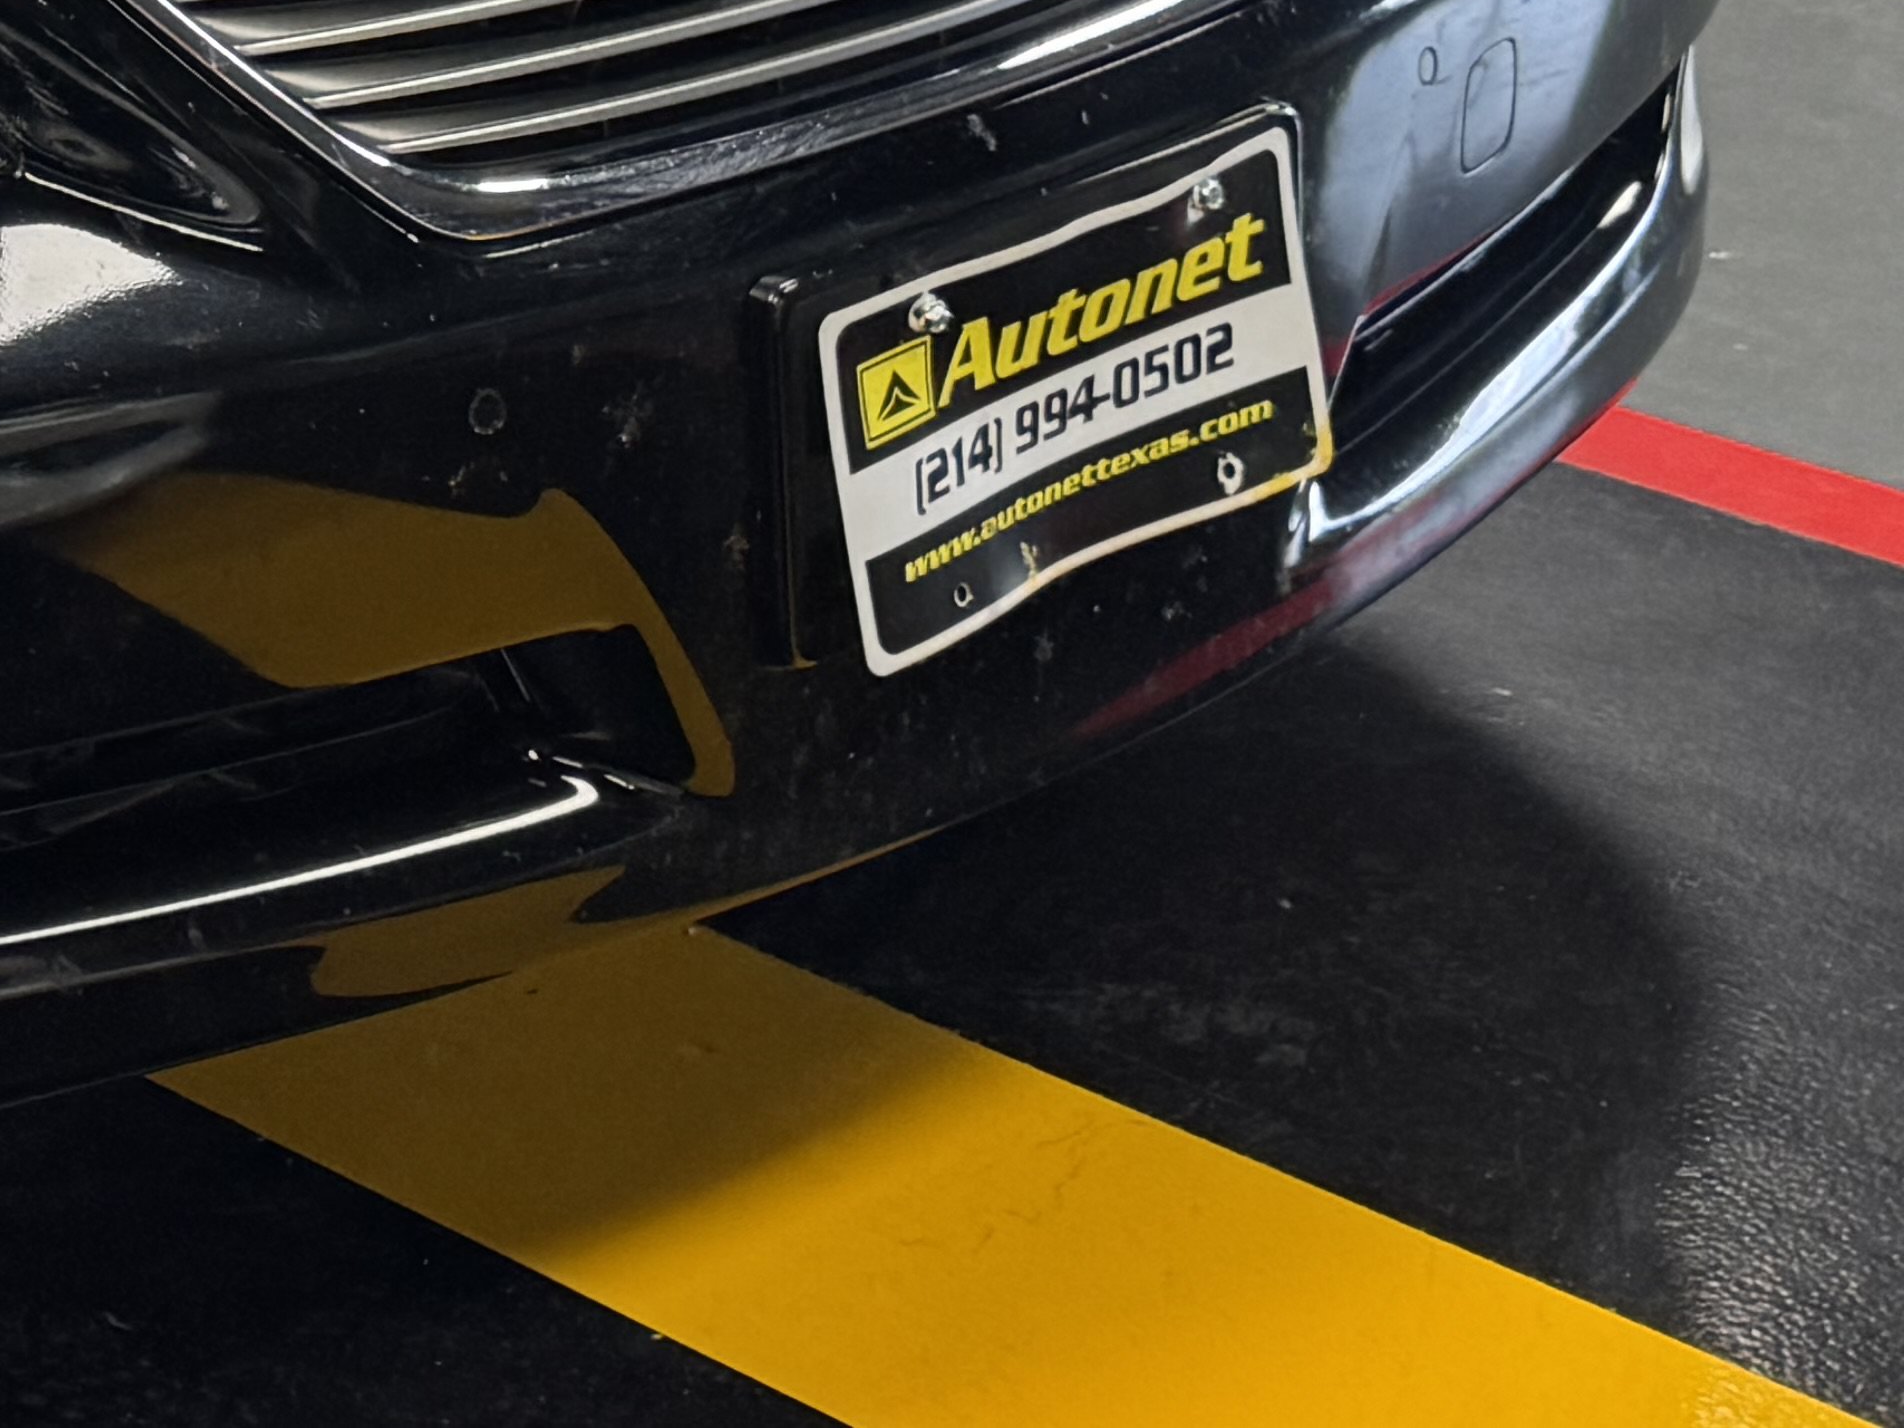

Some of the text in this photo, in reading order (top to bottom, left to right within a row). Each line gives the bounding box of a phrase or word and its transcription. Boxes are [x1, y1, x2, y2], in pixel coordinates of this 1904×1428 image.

[936, 213, 1265, 409] Autonet
[904, 399, 1274, 582] www.autonettexas.com
[915, 322, 1234, 515] (214) 994-0502
